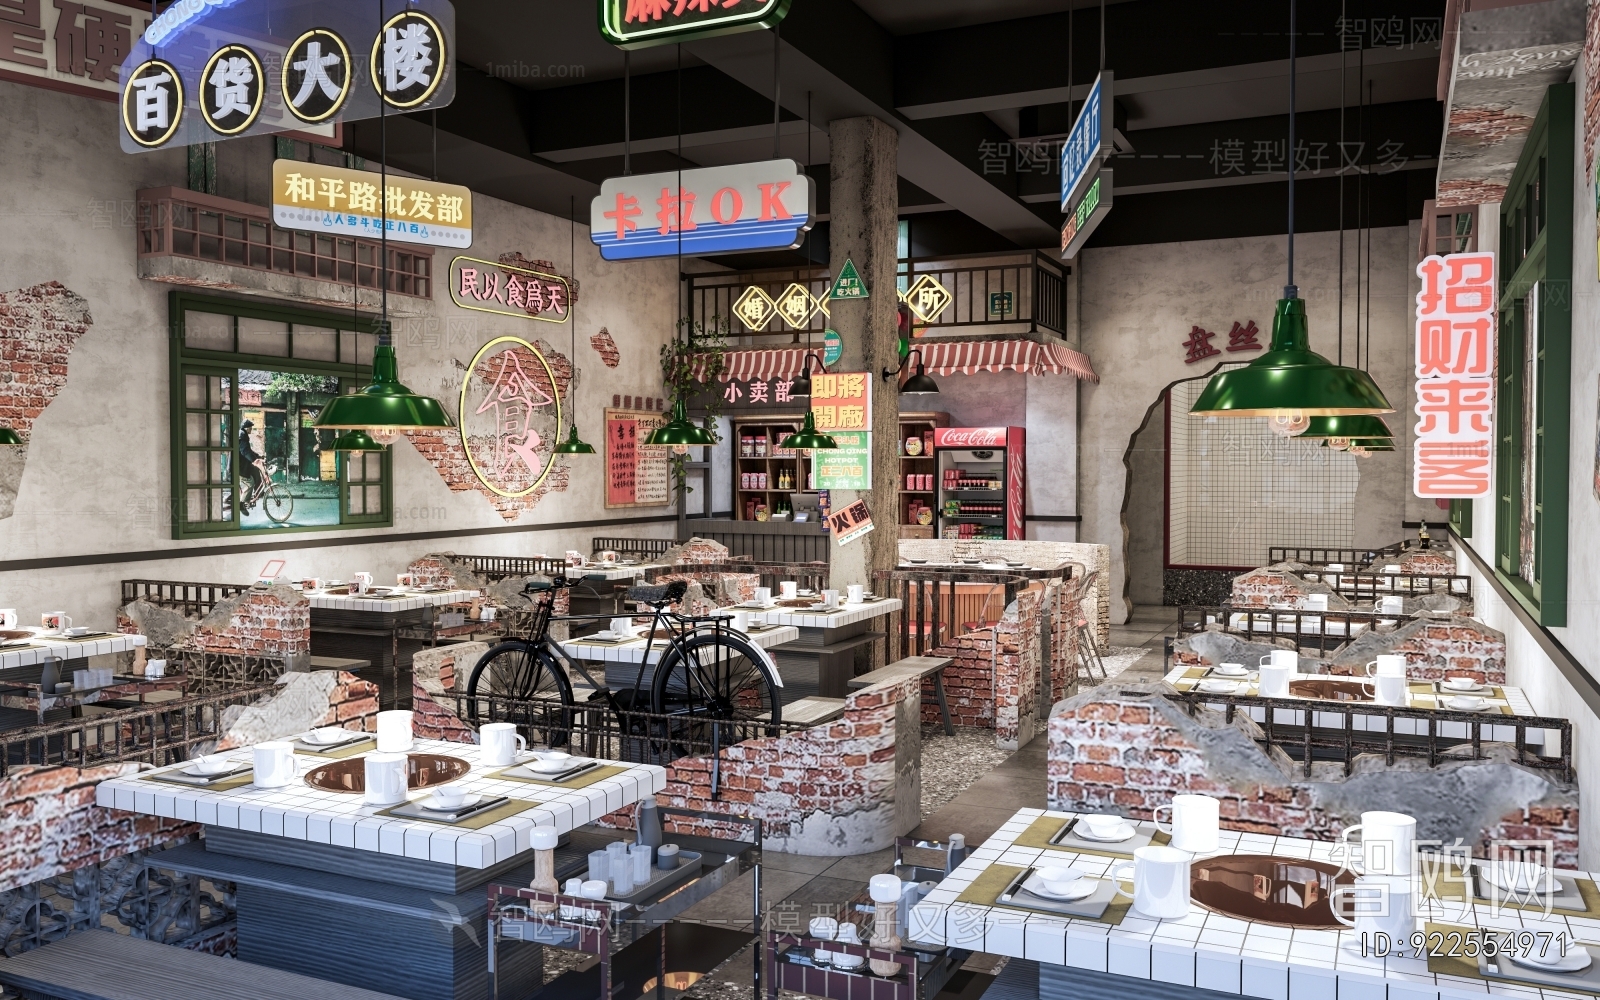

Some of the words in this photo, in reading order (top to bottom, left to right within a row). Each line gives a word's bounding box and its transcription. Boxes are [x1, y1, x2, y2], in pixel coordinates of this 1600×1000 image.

[133, 22, 431, 132] 百货大楼
[284, 172, 464, 224] 和平路批发部
[724, 380, 795, 404] 小卖部
[940, 428, 998, 446] Coca-Cola
[846, 448, 868, 456] QING
[831, 502, 869, 533] 火锅
